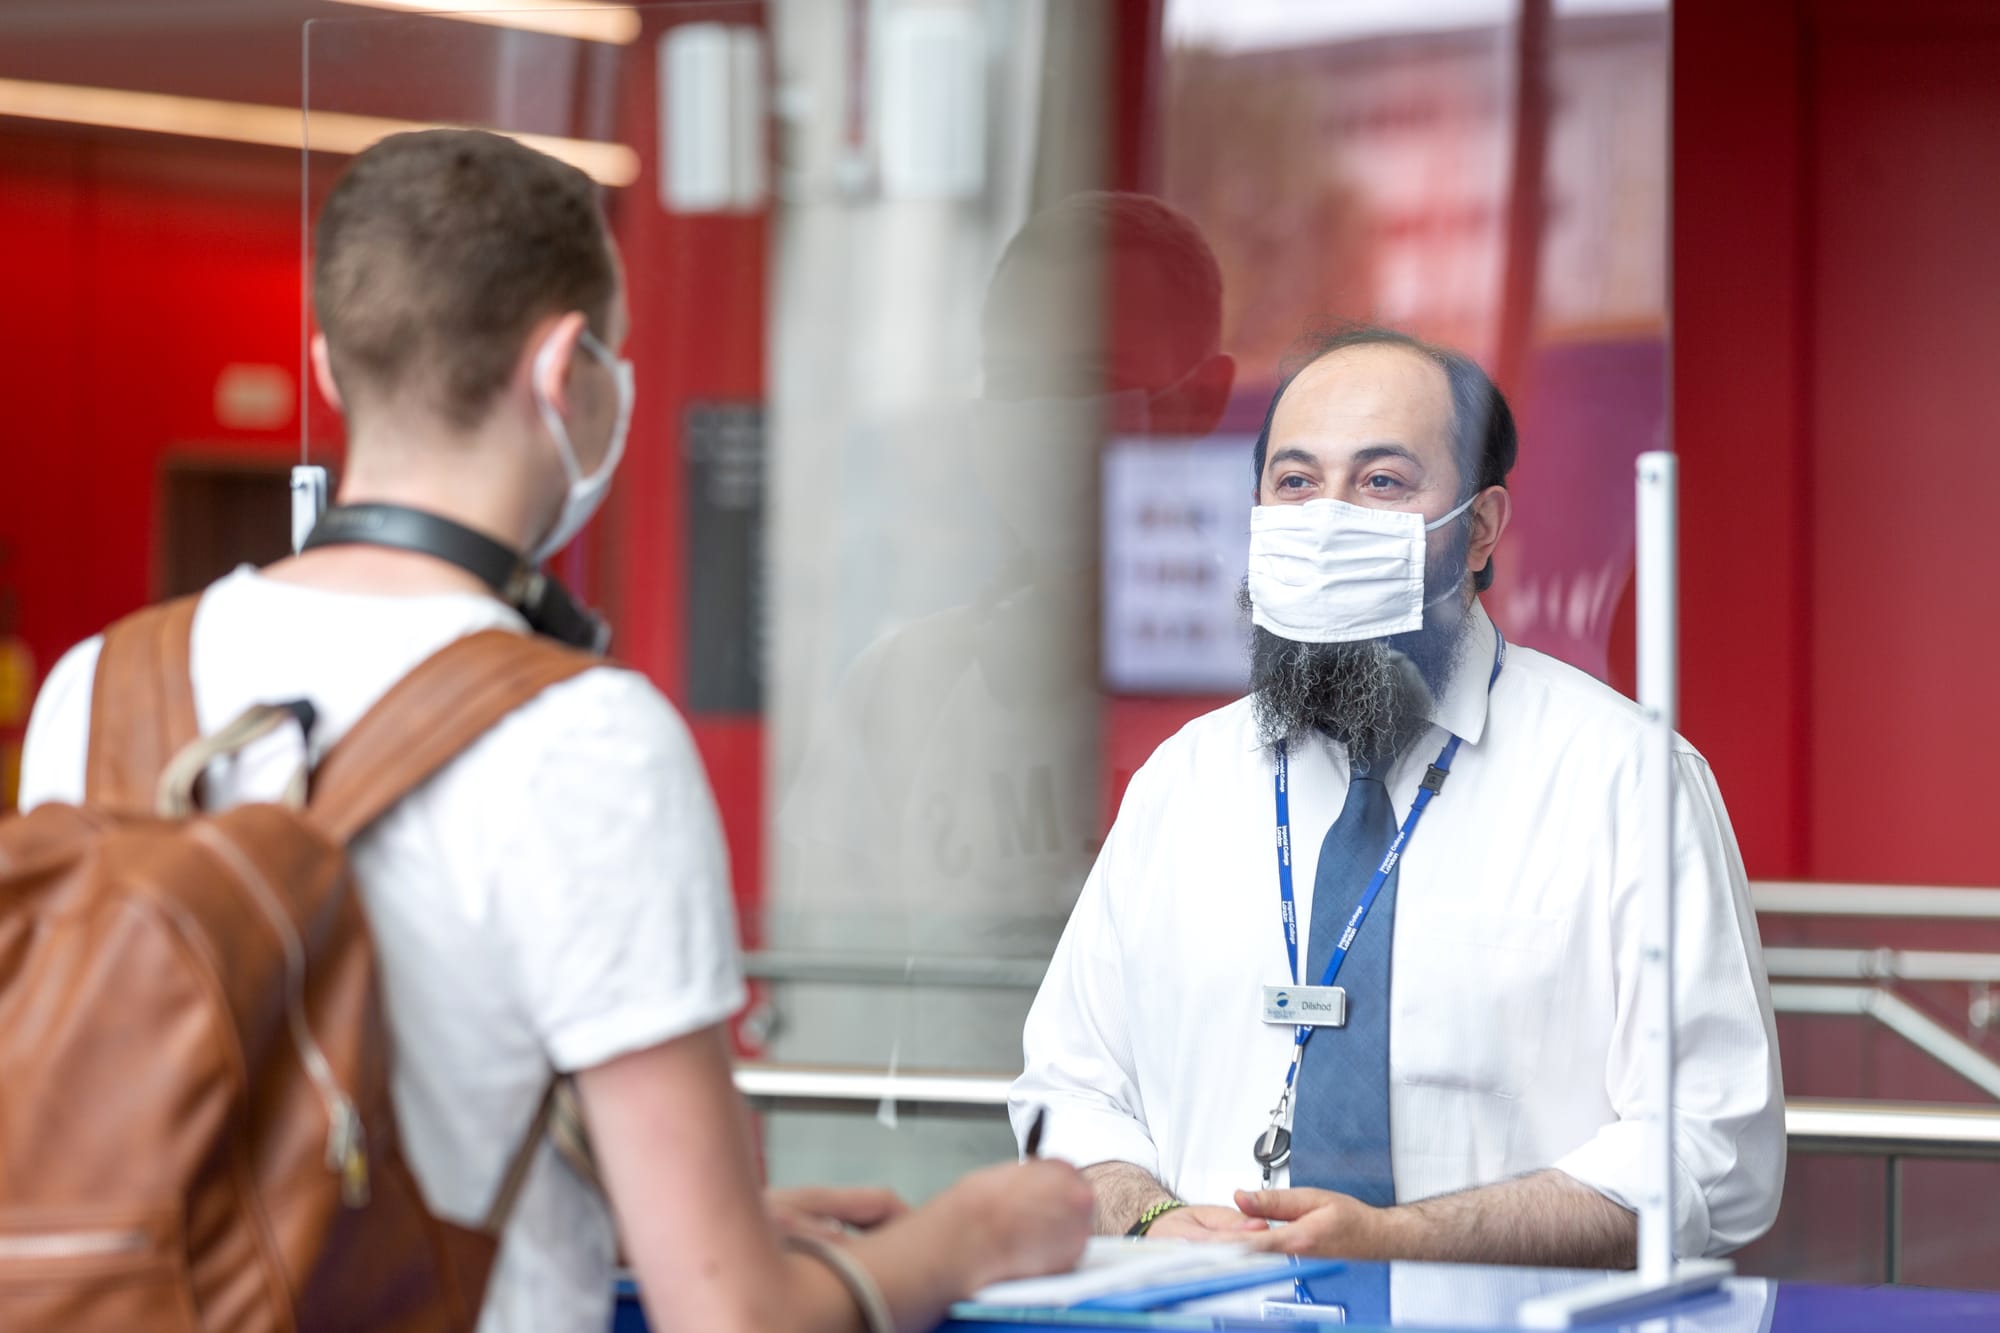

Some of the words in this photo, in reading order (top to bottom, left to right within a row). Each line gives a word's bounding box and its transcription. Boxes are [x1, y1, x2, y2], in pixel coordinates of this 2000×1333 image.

[1378, 850, 1394, 872] Imperial
[1390, 831, 1405, 851] College
[1383, 852, 1400, 874] London
[1337, 925, 1352, 948] Imperial
[1349, 905, 1364, 927] College
[1342, 928, 1358, 951] London
[1302, 1001, 1333, 1012] Dilshod
